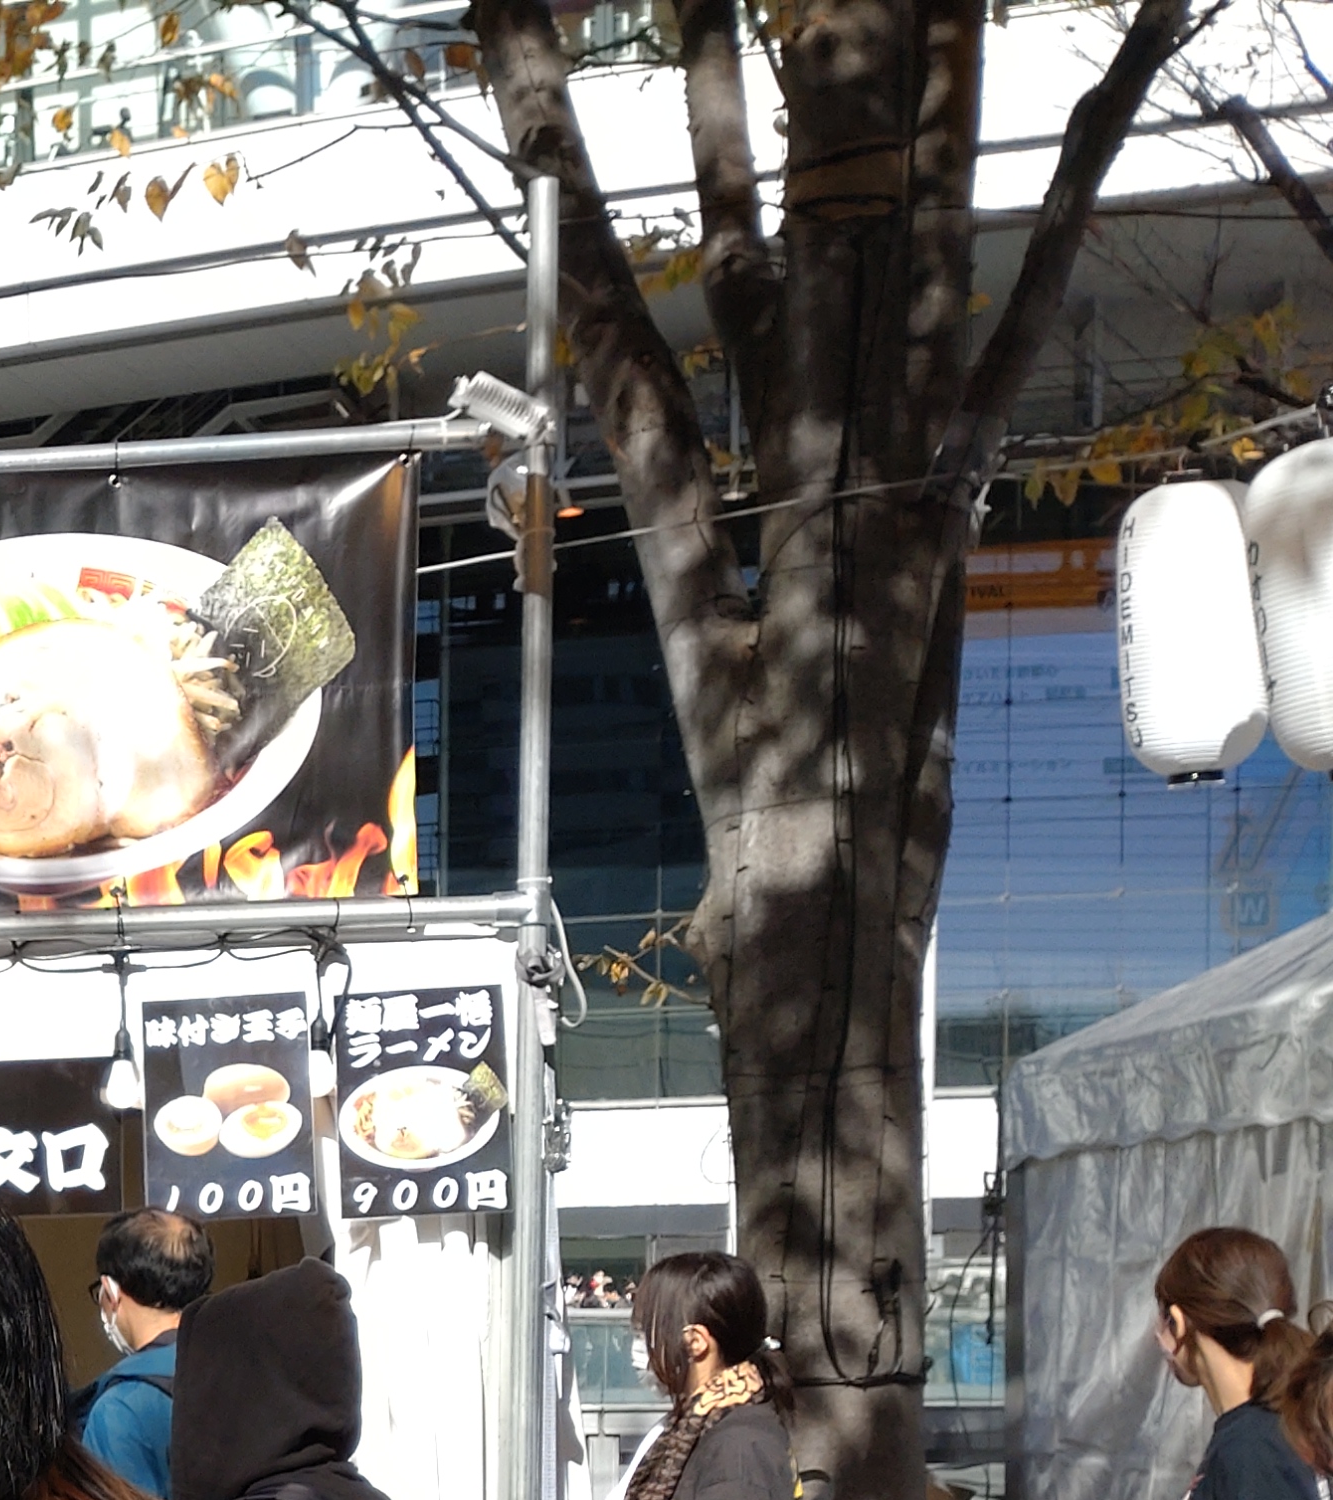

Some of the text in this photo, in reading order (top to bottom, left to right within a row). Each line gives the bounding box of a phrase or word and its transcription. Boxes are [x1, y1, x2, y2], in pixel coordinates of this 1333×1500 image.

[348, 1028, 491, 1068] ラーメン
[166, 1172, 311, 1212] 100円
[353, 1169, 507, 1213] 900円
